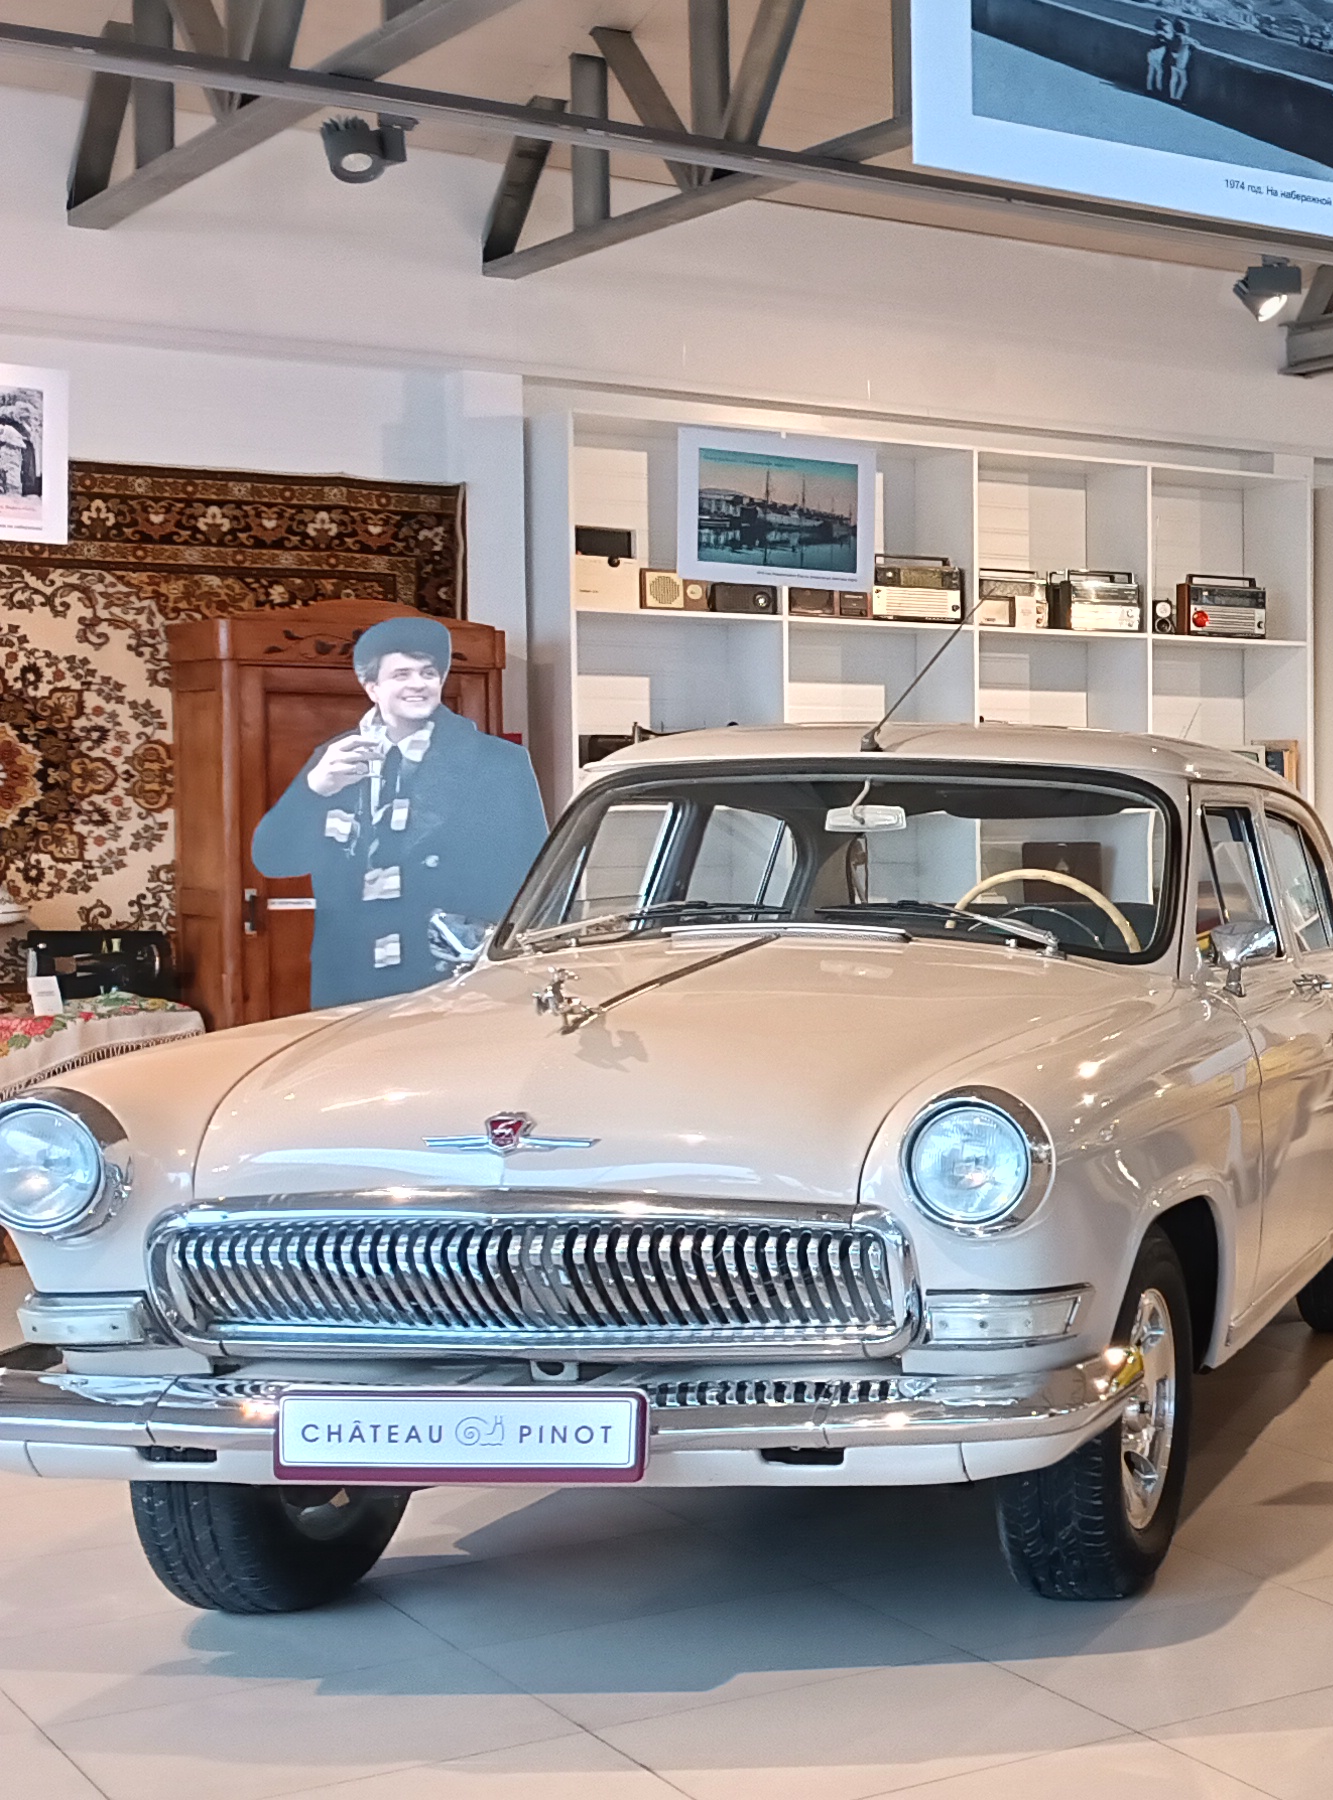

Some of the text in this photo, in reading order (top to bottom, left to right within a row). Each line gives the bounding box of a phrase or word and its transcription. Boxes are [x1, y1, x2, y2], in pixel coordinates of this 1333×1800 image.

[1224, 178, 1245, 190] 1974
[1266, 186, 1279, 197] На
[1280, 189, 1332, 206] набережной
[301, 1420, 613, 1444] CHÂTEAU PINOT
